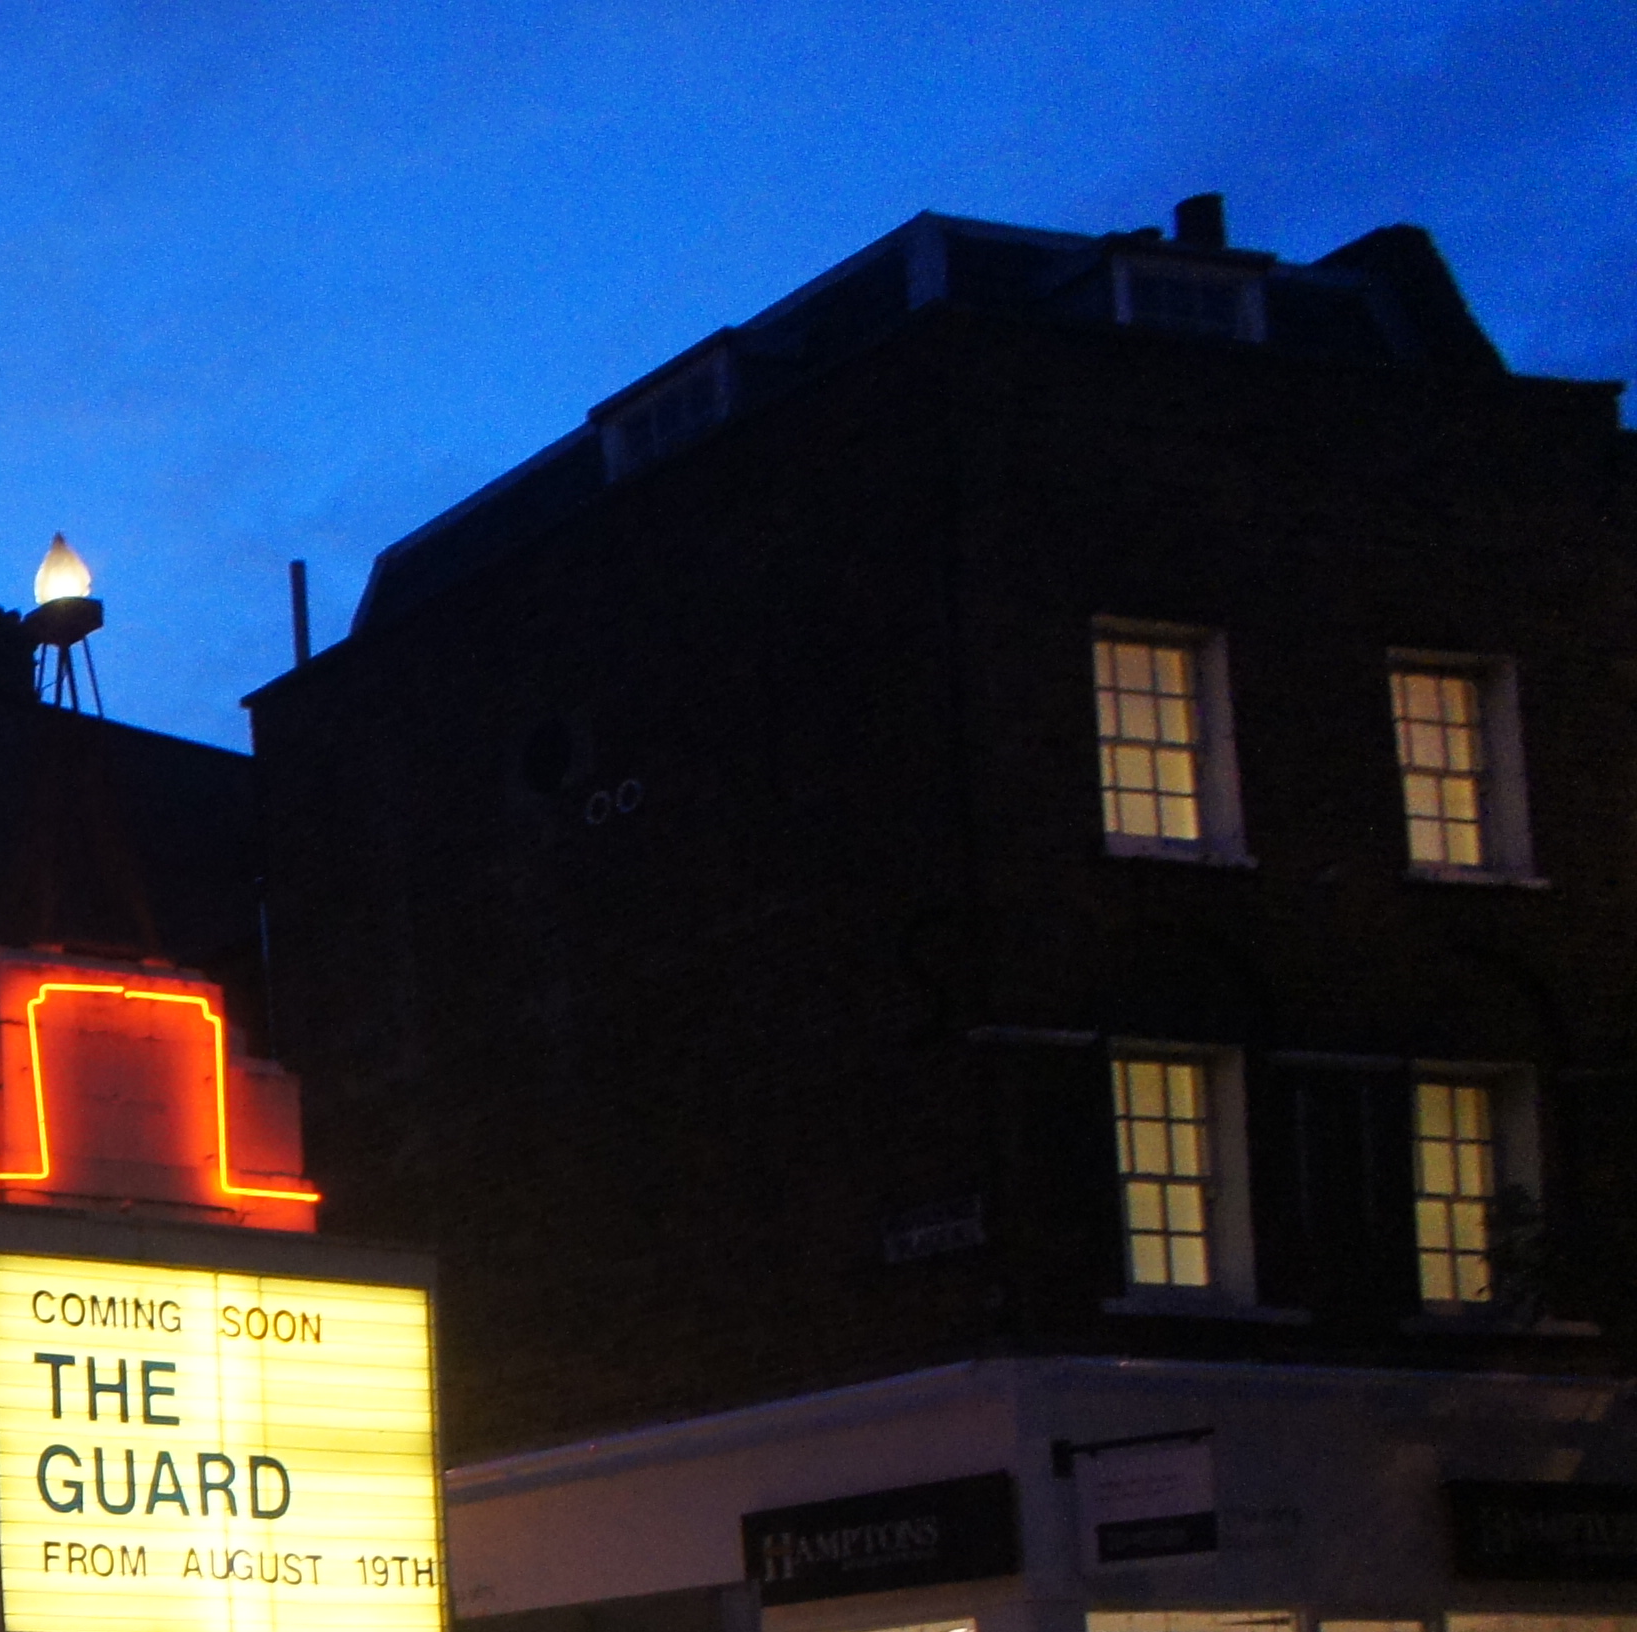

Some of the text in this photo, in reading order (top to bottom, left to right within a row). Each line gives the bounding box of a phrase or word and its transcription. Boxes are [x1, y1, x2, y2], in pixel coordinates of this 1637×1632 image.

[32, 1290, 322, 1343] COMING SOON
[34, 1352, 180, 1426] THE
[37, 1444, 291, 1519] GUARD
[43, 1541, 436, 1588] FROM AUGUST 19TH
